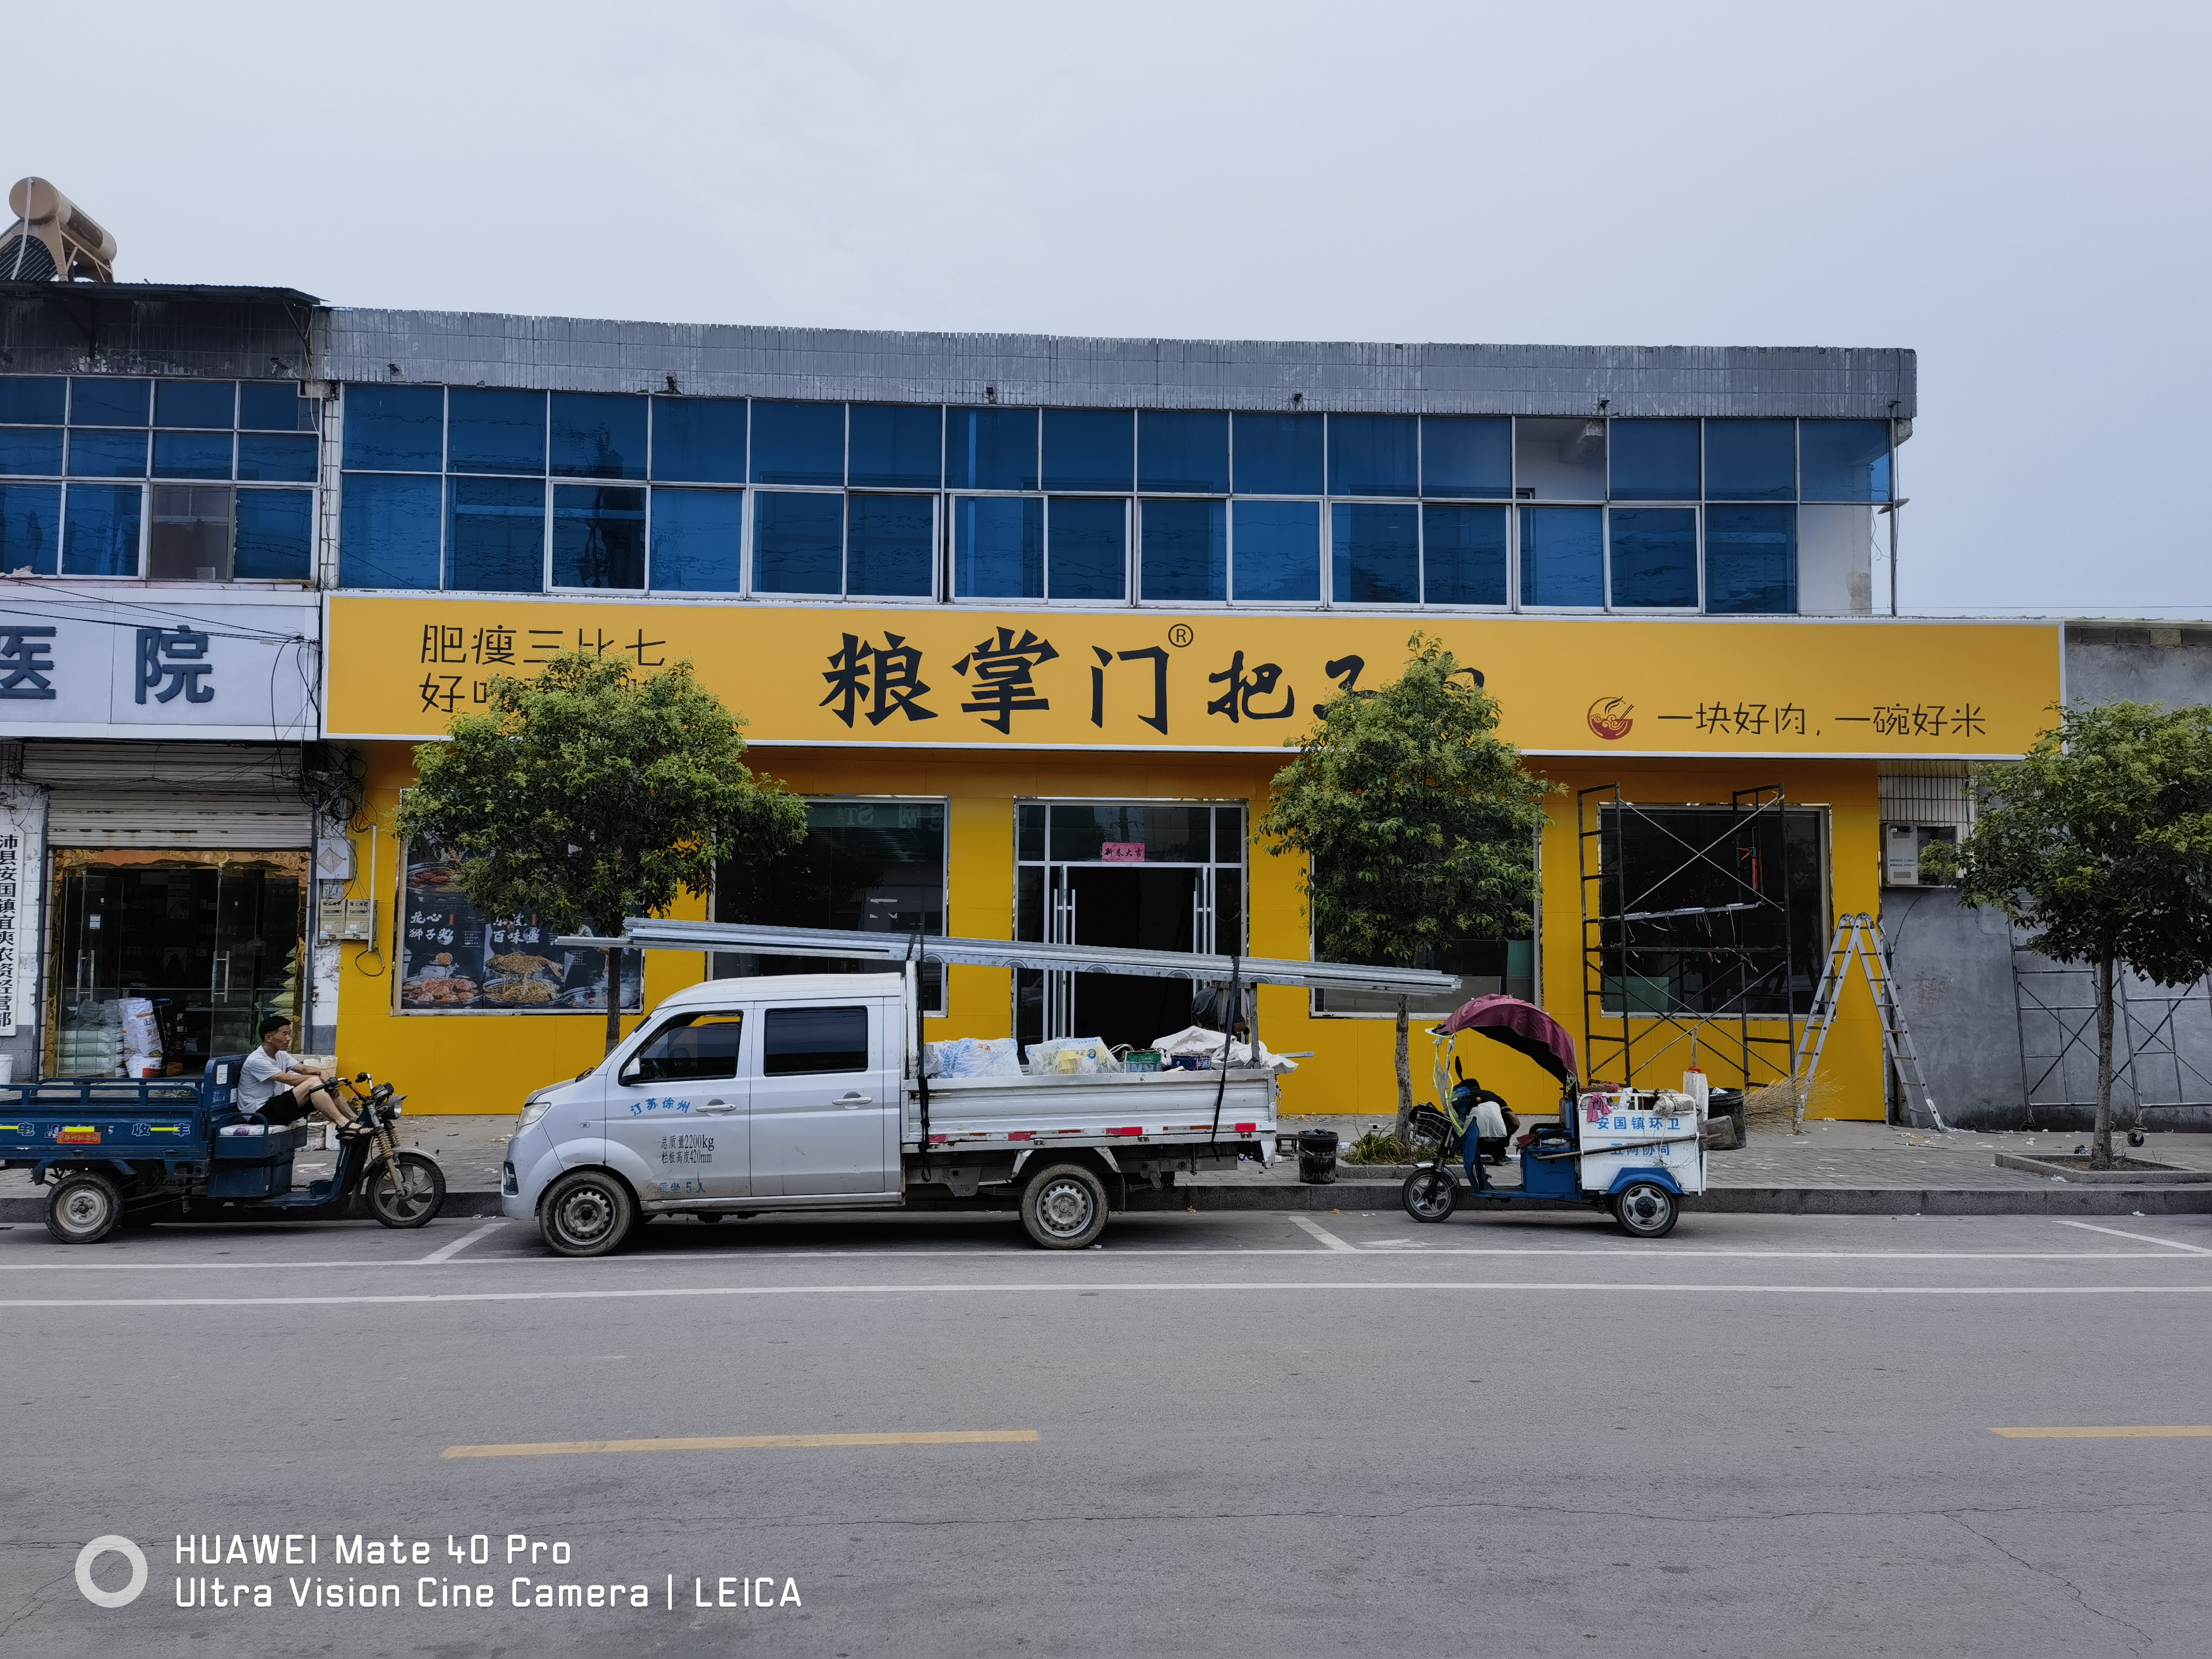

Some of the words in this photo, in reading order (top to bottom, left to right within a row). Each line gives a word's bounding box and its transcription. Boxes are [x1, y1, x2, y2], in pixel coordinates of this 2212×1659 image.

[421, 624, 666, 666] 肥瘦三比七
[0, 625, 215, 704] 医院
[819, 626, 1170, 736] 粮掌门
[1104, 847, 1143, 857] 新春大吉
[493, 928, 541, 945] 百味鱼
[630, 1097, 691, 1116] 江苏徐州
[1596, 1116, 1681, 1130] 安国镇环卫
